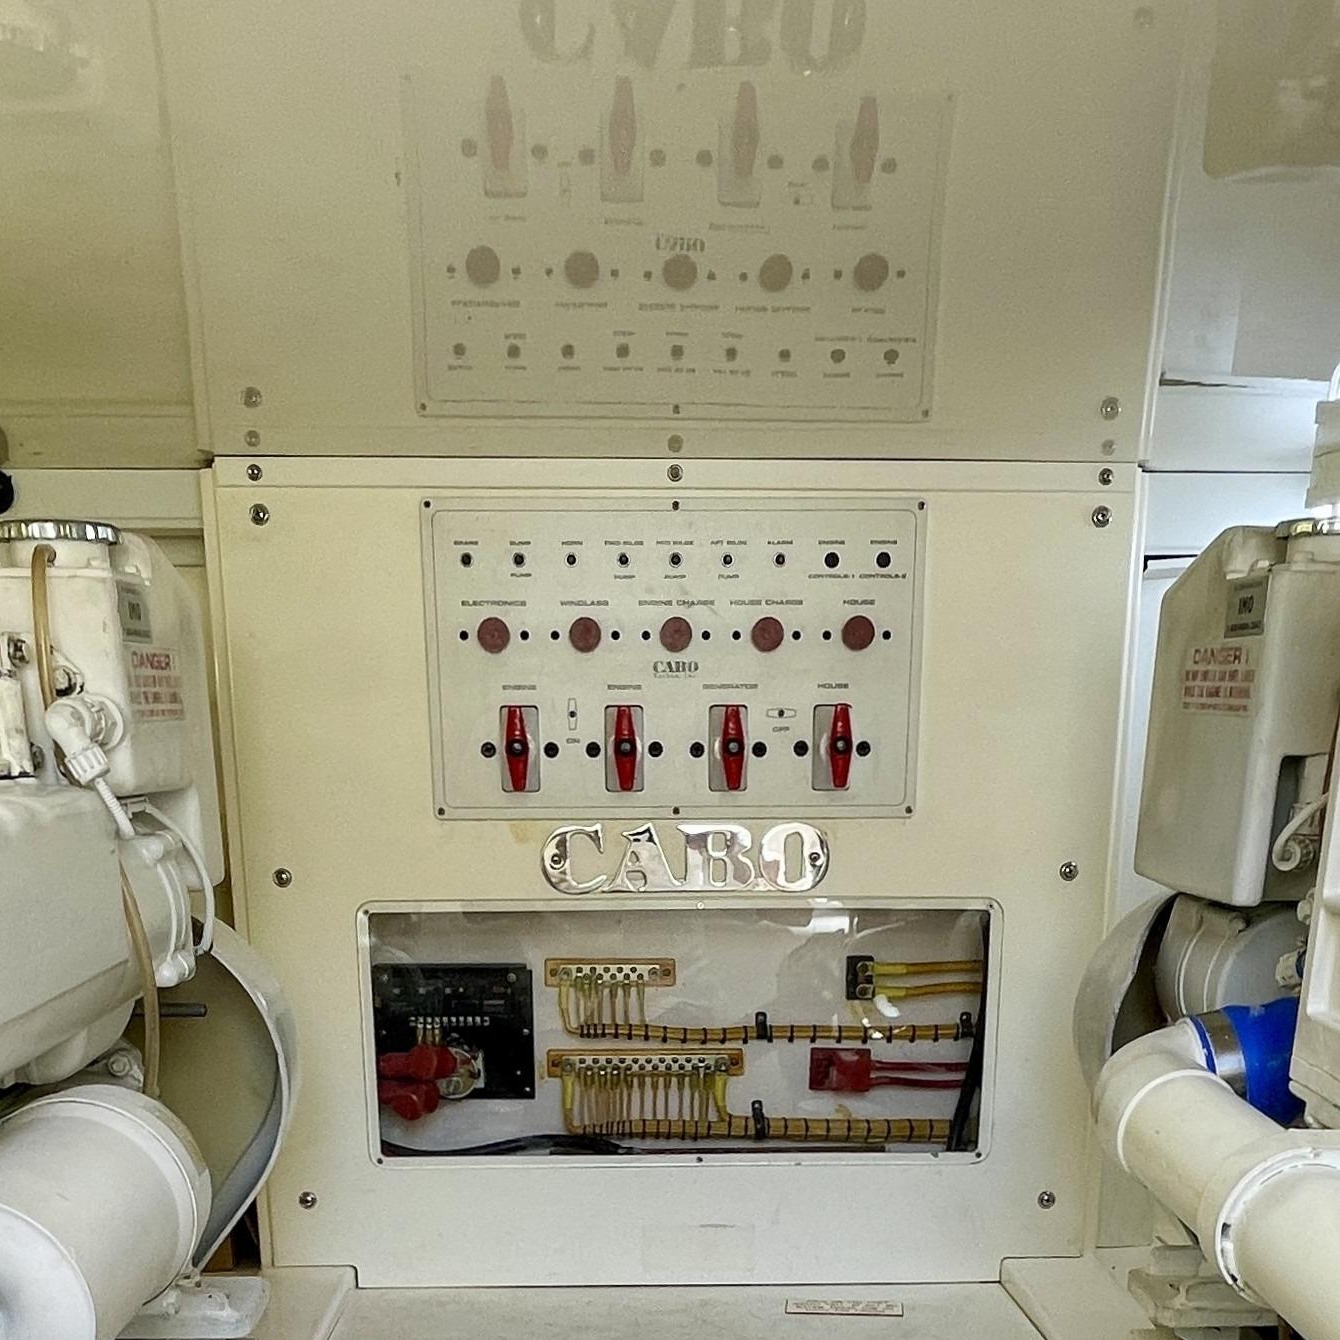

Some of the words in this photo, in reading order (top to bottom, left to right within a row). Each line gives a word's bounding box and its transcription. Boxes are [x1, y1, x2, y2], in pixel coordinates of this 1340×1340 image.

[131, 650, 172, 671] DANGER
[1193, 647, 1242, 665] DANGER
[653, 660, 699, 673] CABO
[542, 822, 829, 895] CABO
